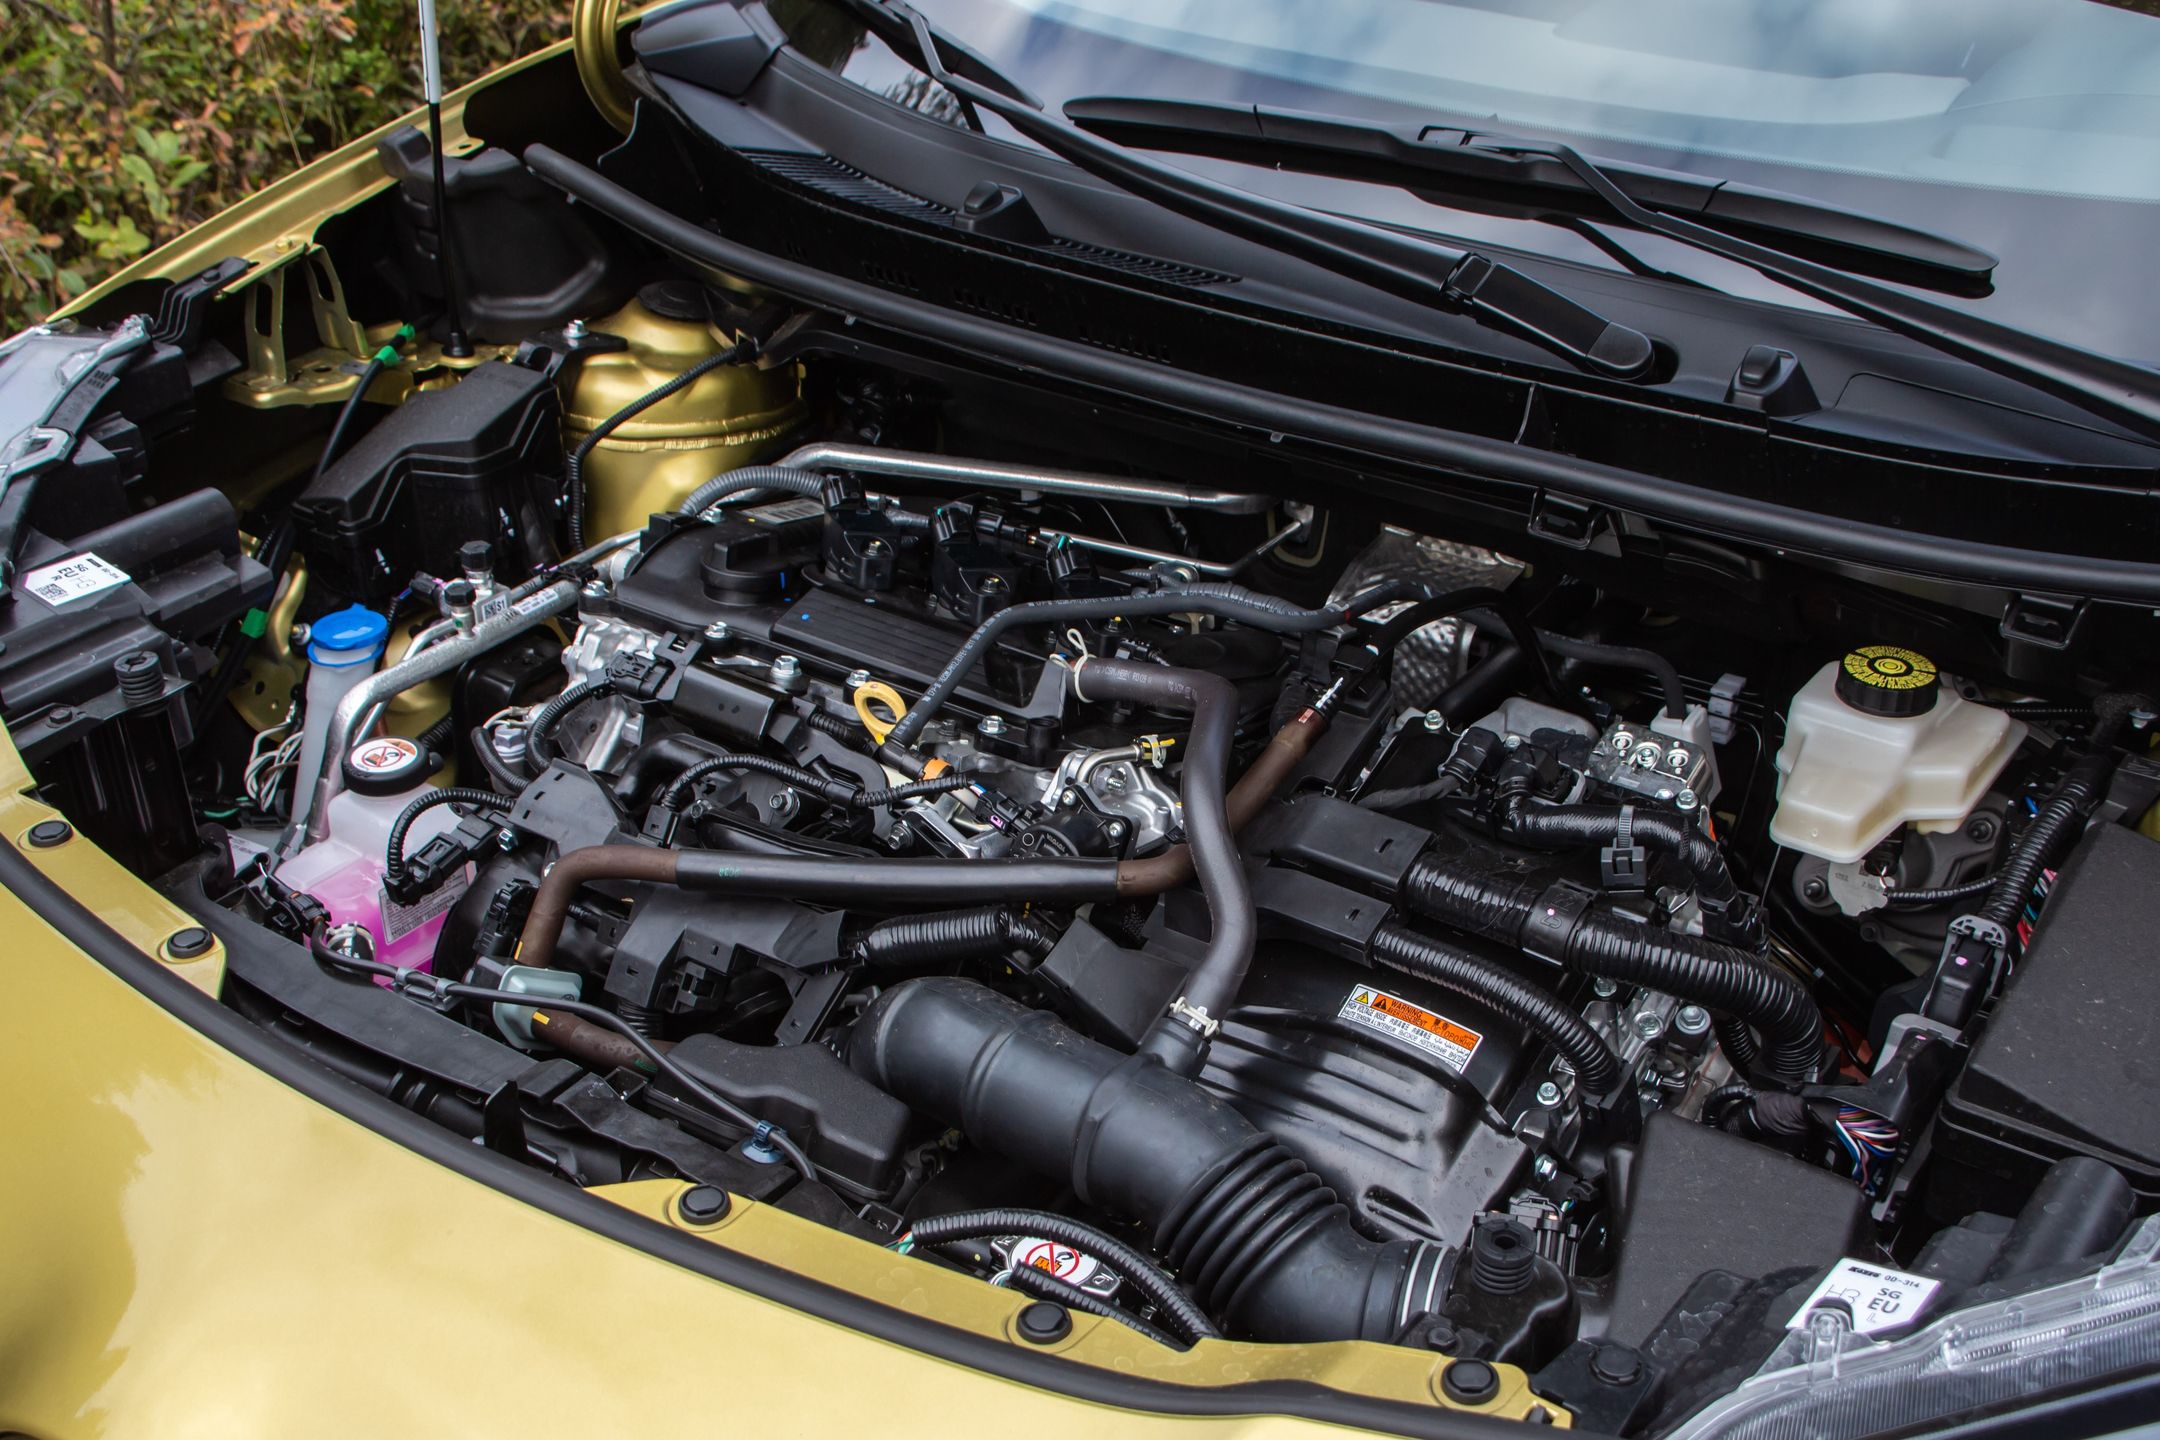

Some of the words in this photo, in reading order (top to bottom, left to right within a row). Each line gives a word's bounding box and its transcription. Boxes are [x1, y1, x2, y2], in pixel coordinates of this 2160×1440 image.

[57, 566, 79, 578] EU
[1046, 833, 1066, 852] TOYOTA
[1357, 1004, 1375, 1016] VOLTAGE
[1391, 1000, 1422, 1018] WARNING
[1877, 1288, 1903, 1300] SG
[1867, 1298, 1900, 1314] EU
